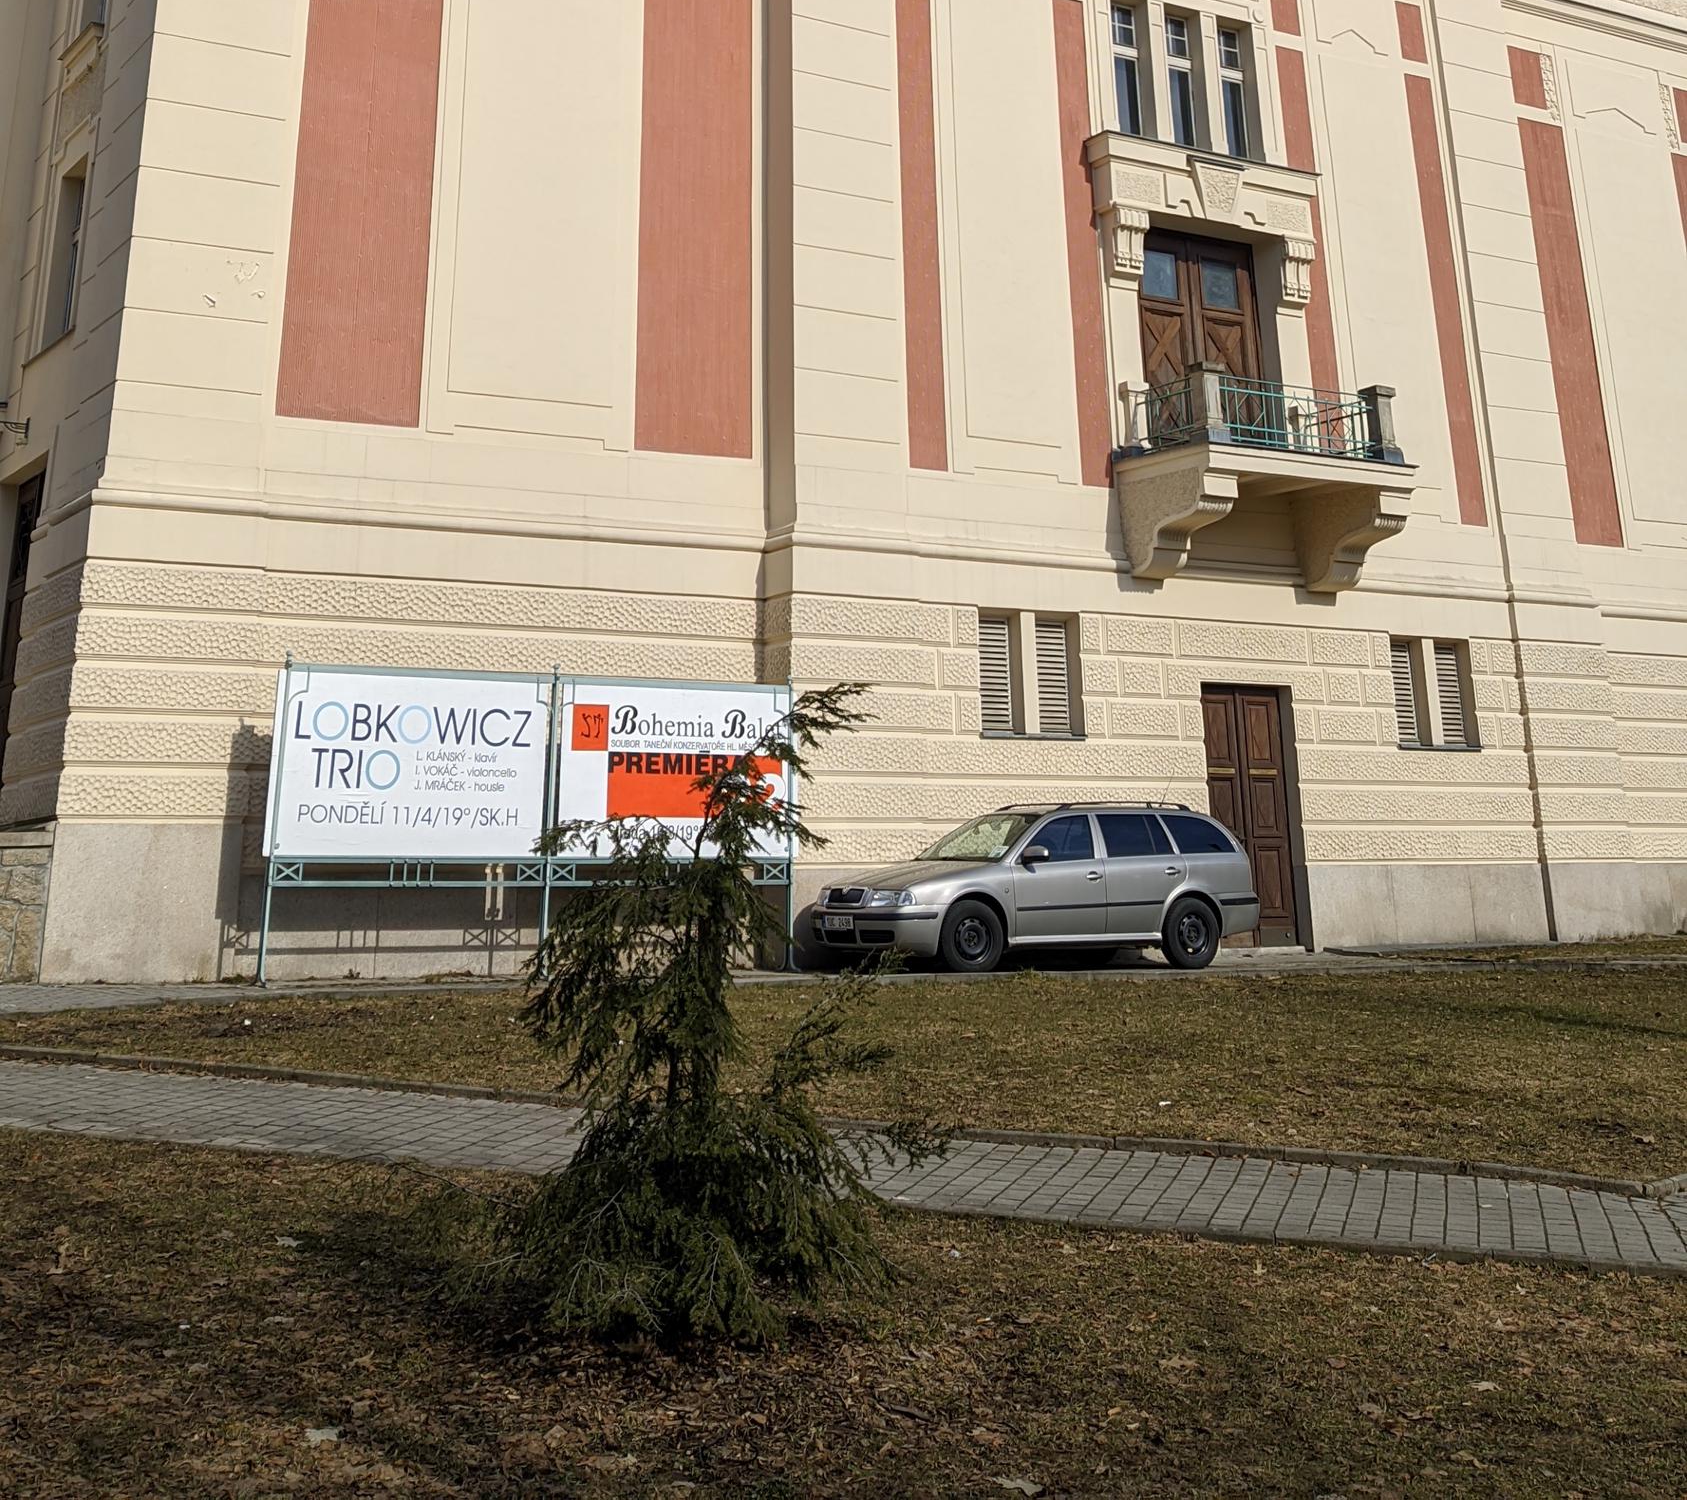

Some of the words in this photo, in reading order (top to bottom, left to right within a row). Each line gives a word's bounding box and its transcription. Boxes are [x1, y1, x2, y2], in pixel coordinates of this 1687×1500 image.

[294, 700, 533, 748] LOBKOWICZ
[611, 704, 714, 738] Bohemia
[610, 739, 641, 749] SOUBOR
[643, 738, 673, 749] TANEČNÍ
[673, 741, 726, 751] KONZERVATOŘE
[416, 750, 423, 761] L.
[426, 748, 466, 762] KLÁNSKÝ
[474, 751, 498, 763] klavír
[311, 747, 401, 791] TRIO
[423, 763, 458, 776] VOKÁČ
[467, 767, 517, 778] violoncello
[414, 779, 421, 790] J.
[424, 777, 466, 791] MRÁČEK
[474, 782, 505, 792] housle
[297, 801, 388, 825] PONDĚLÍ
